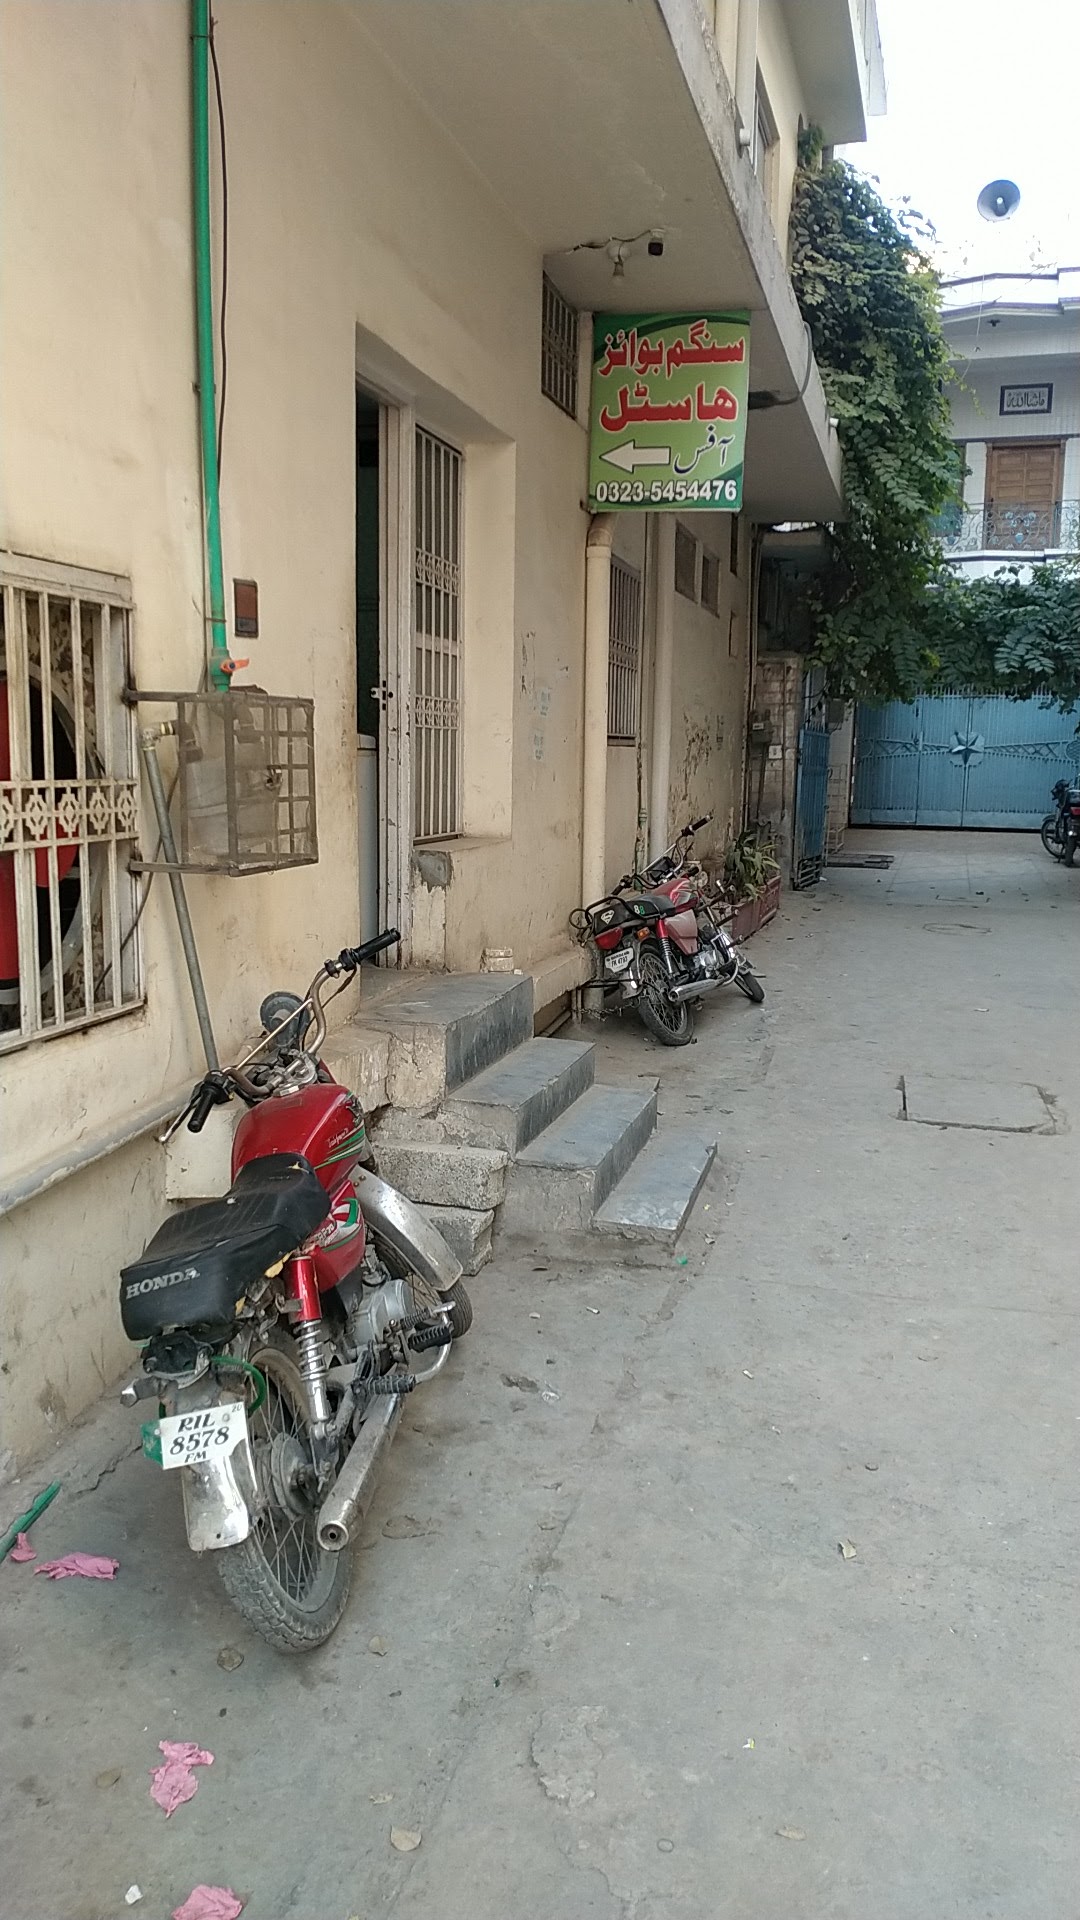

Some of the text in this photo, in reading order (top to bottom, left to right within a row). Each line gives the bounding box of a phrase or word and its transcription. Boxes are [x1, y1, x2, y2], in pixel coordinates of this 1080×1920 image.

[666, 319, 745, 379] سنگم
[596, 479, 737, 503] 0323-5454476
[126, 1267, 200, 1300] HONDA
[231, 1403, 242, 1413] 20
[178, 1412, 215, 1433] RIL
[169, 1426, 229, 1455] 8578
[184, 1450, 207, 1463] FM
